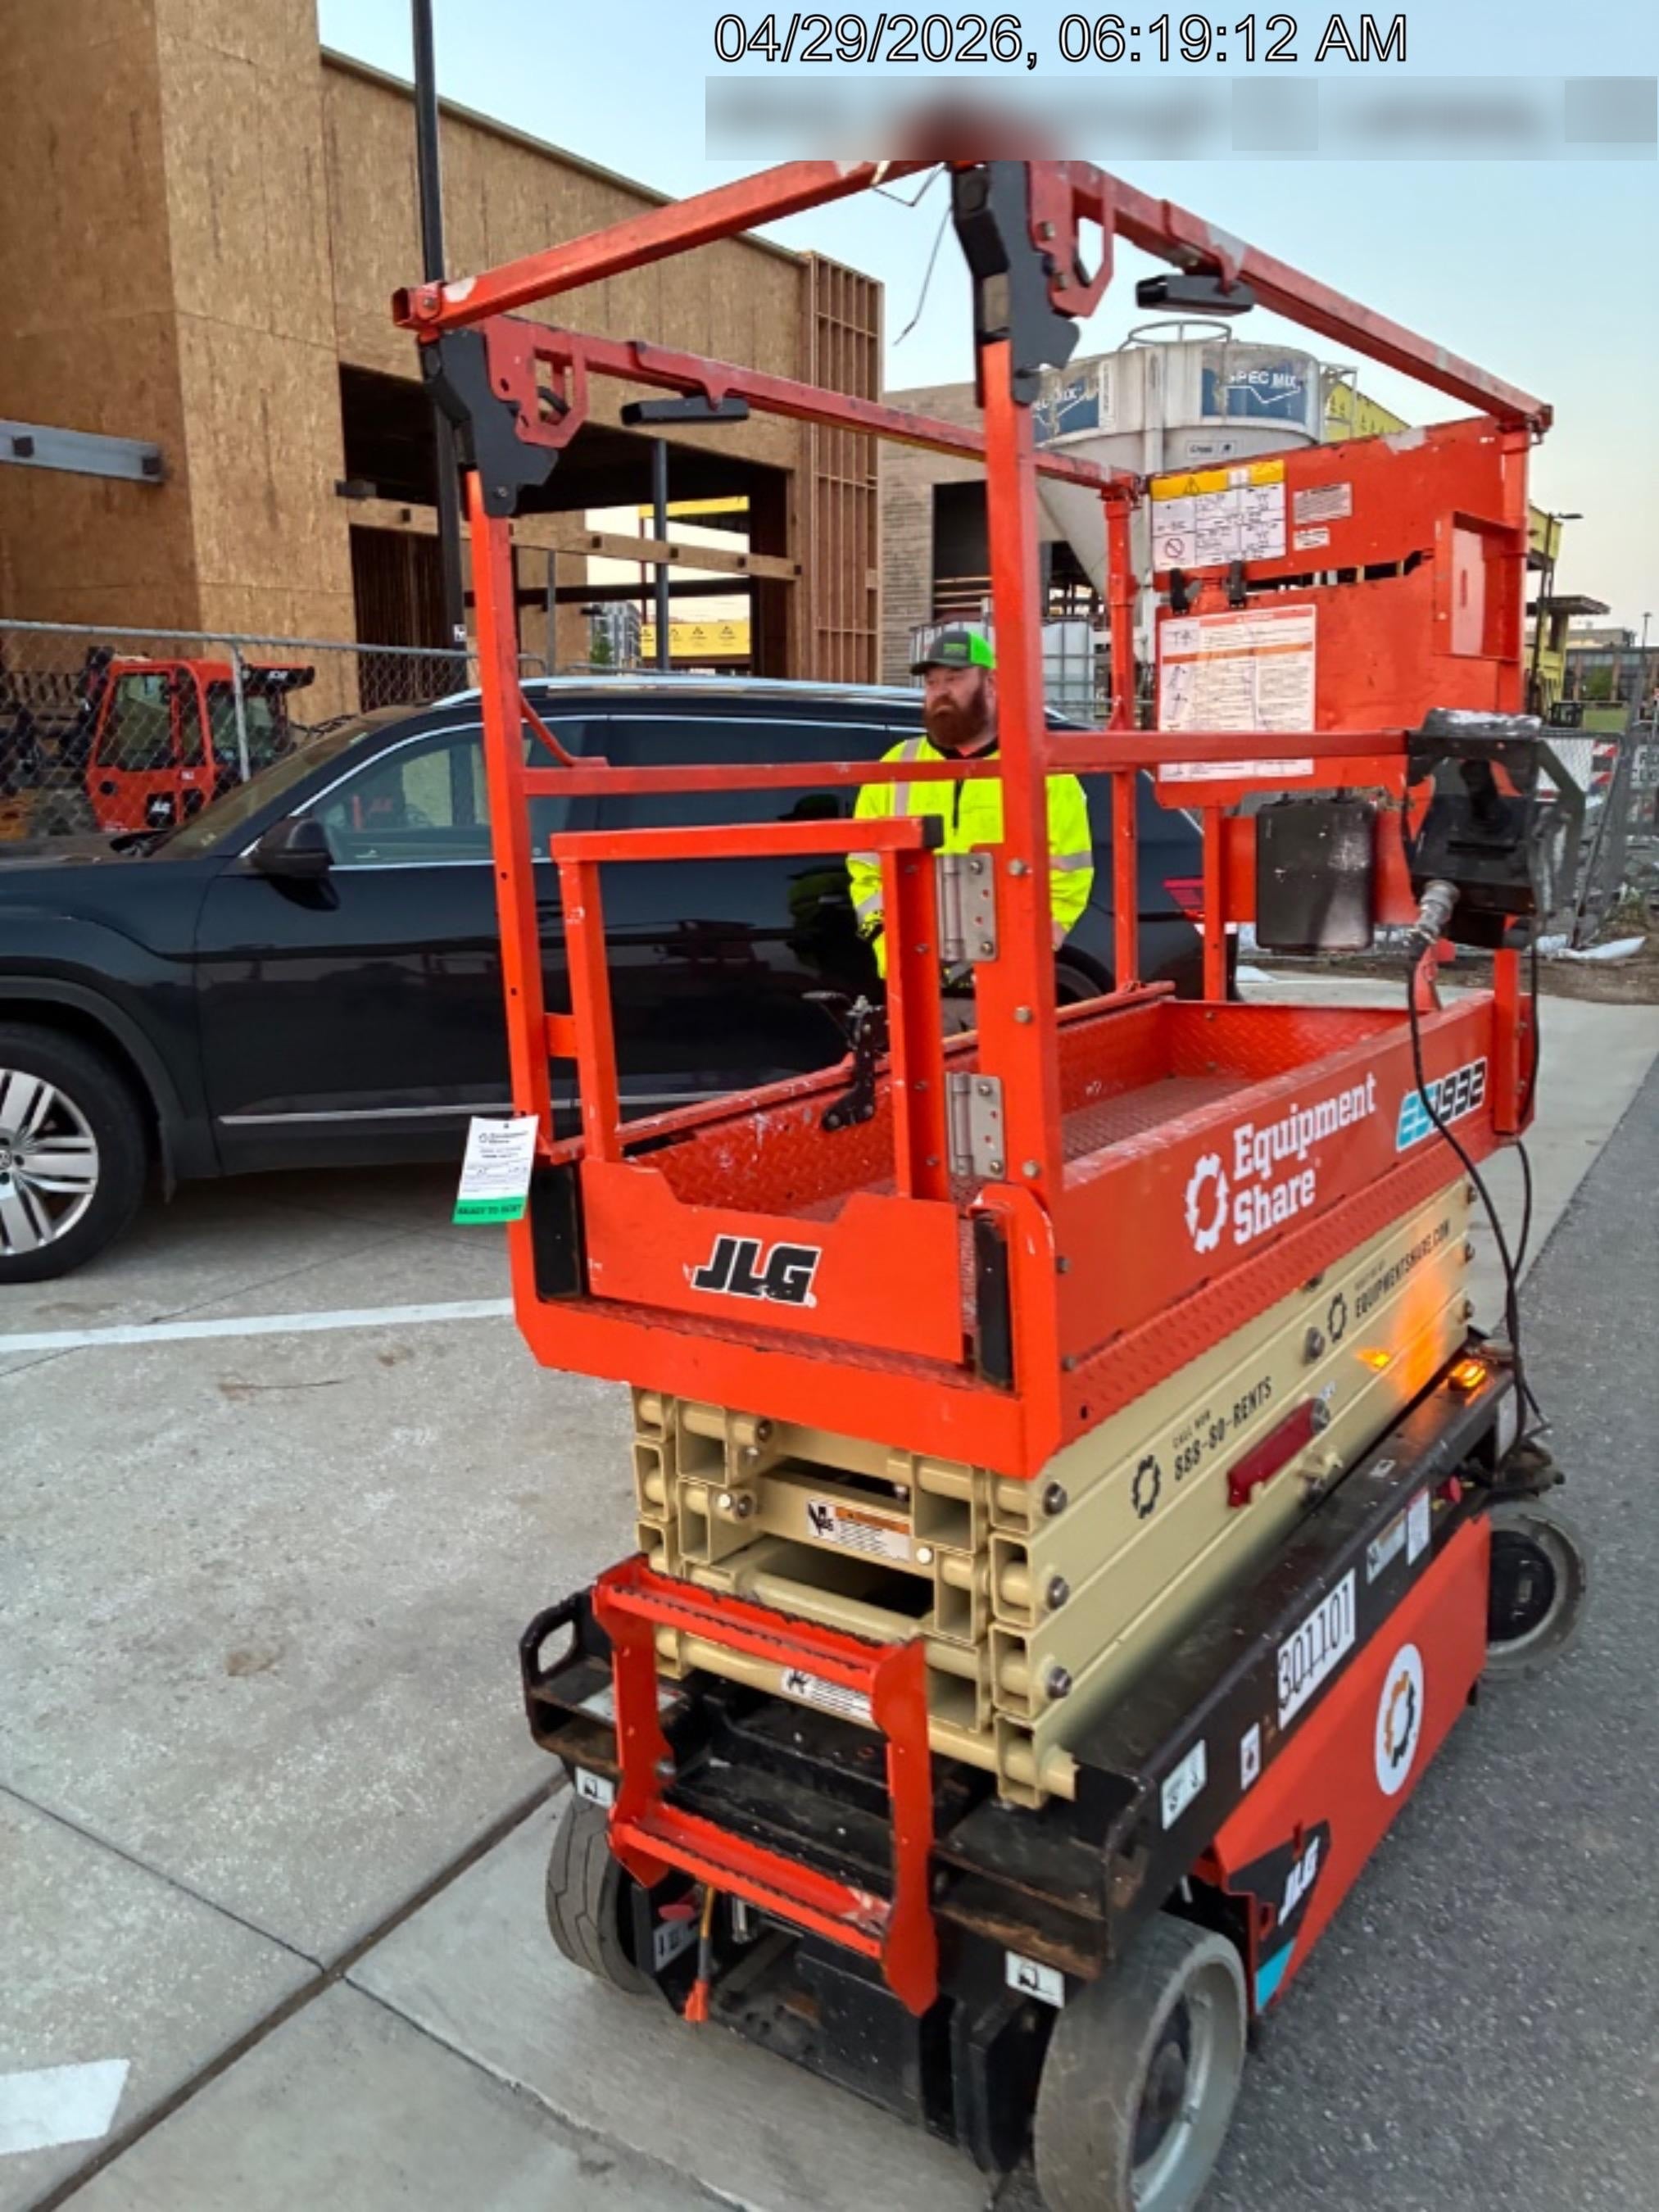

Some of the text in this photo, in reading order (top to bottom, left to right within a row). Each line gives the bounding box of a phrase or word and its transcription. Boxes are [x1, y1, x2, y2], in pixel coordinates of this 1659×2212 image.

[1233, 1072, 1376, 1181] Equipment
[1232, 1168, 1317, 1245] Share
[691, 1233, 823, 1308] JLG
[1174, 1376, 1272, 1481] 888-80-RENTS
[1278, 1581, 1349, 1710] 301101
[1277, 1836, 1321, 1927] JLG
